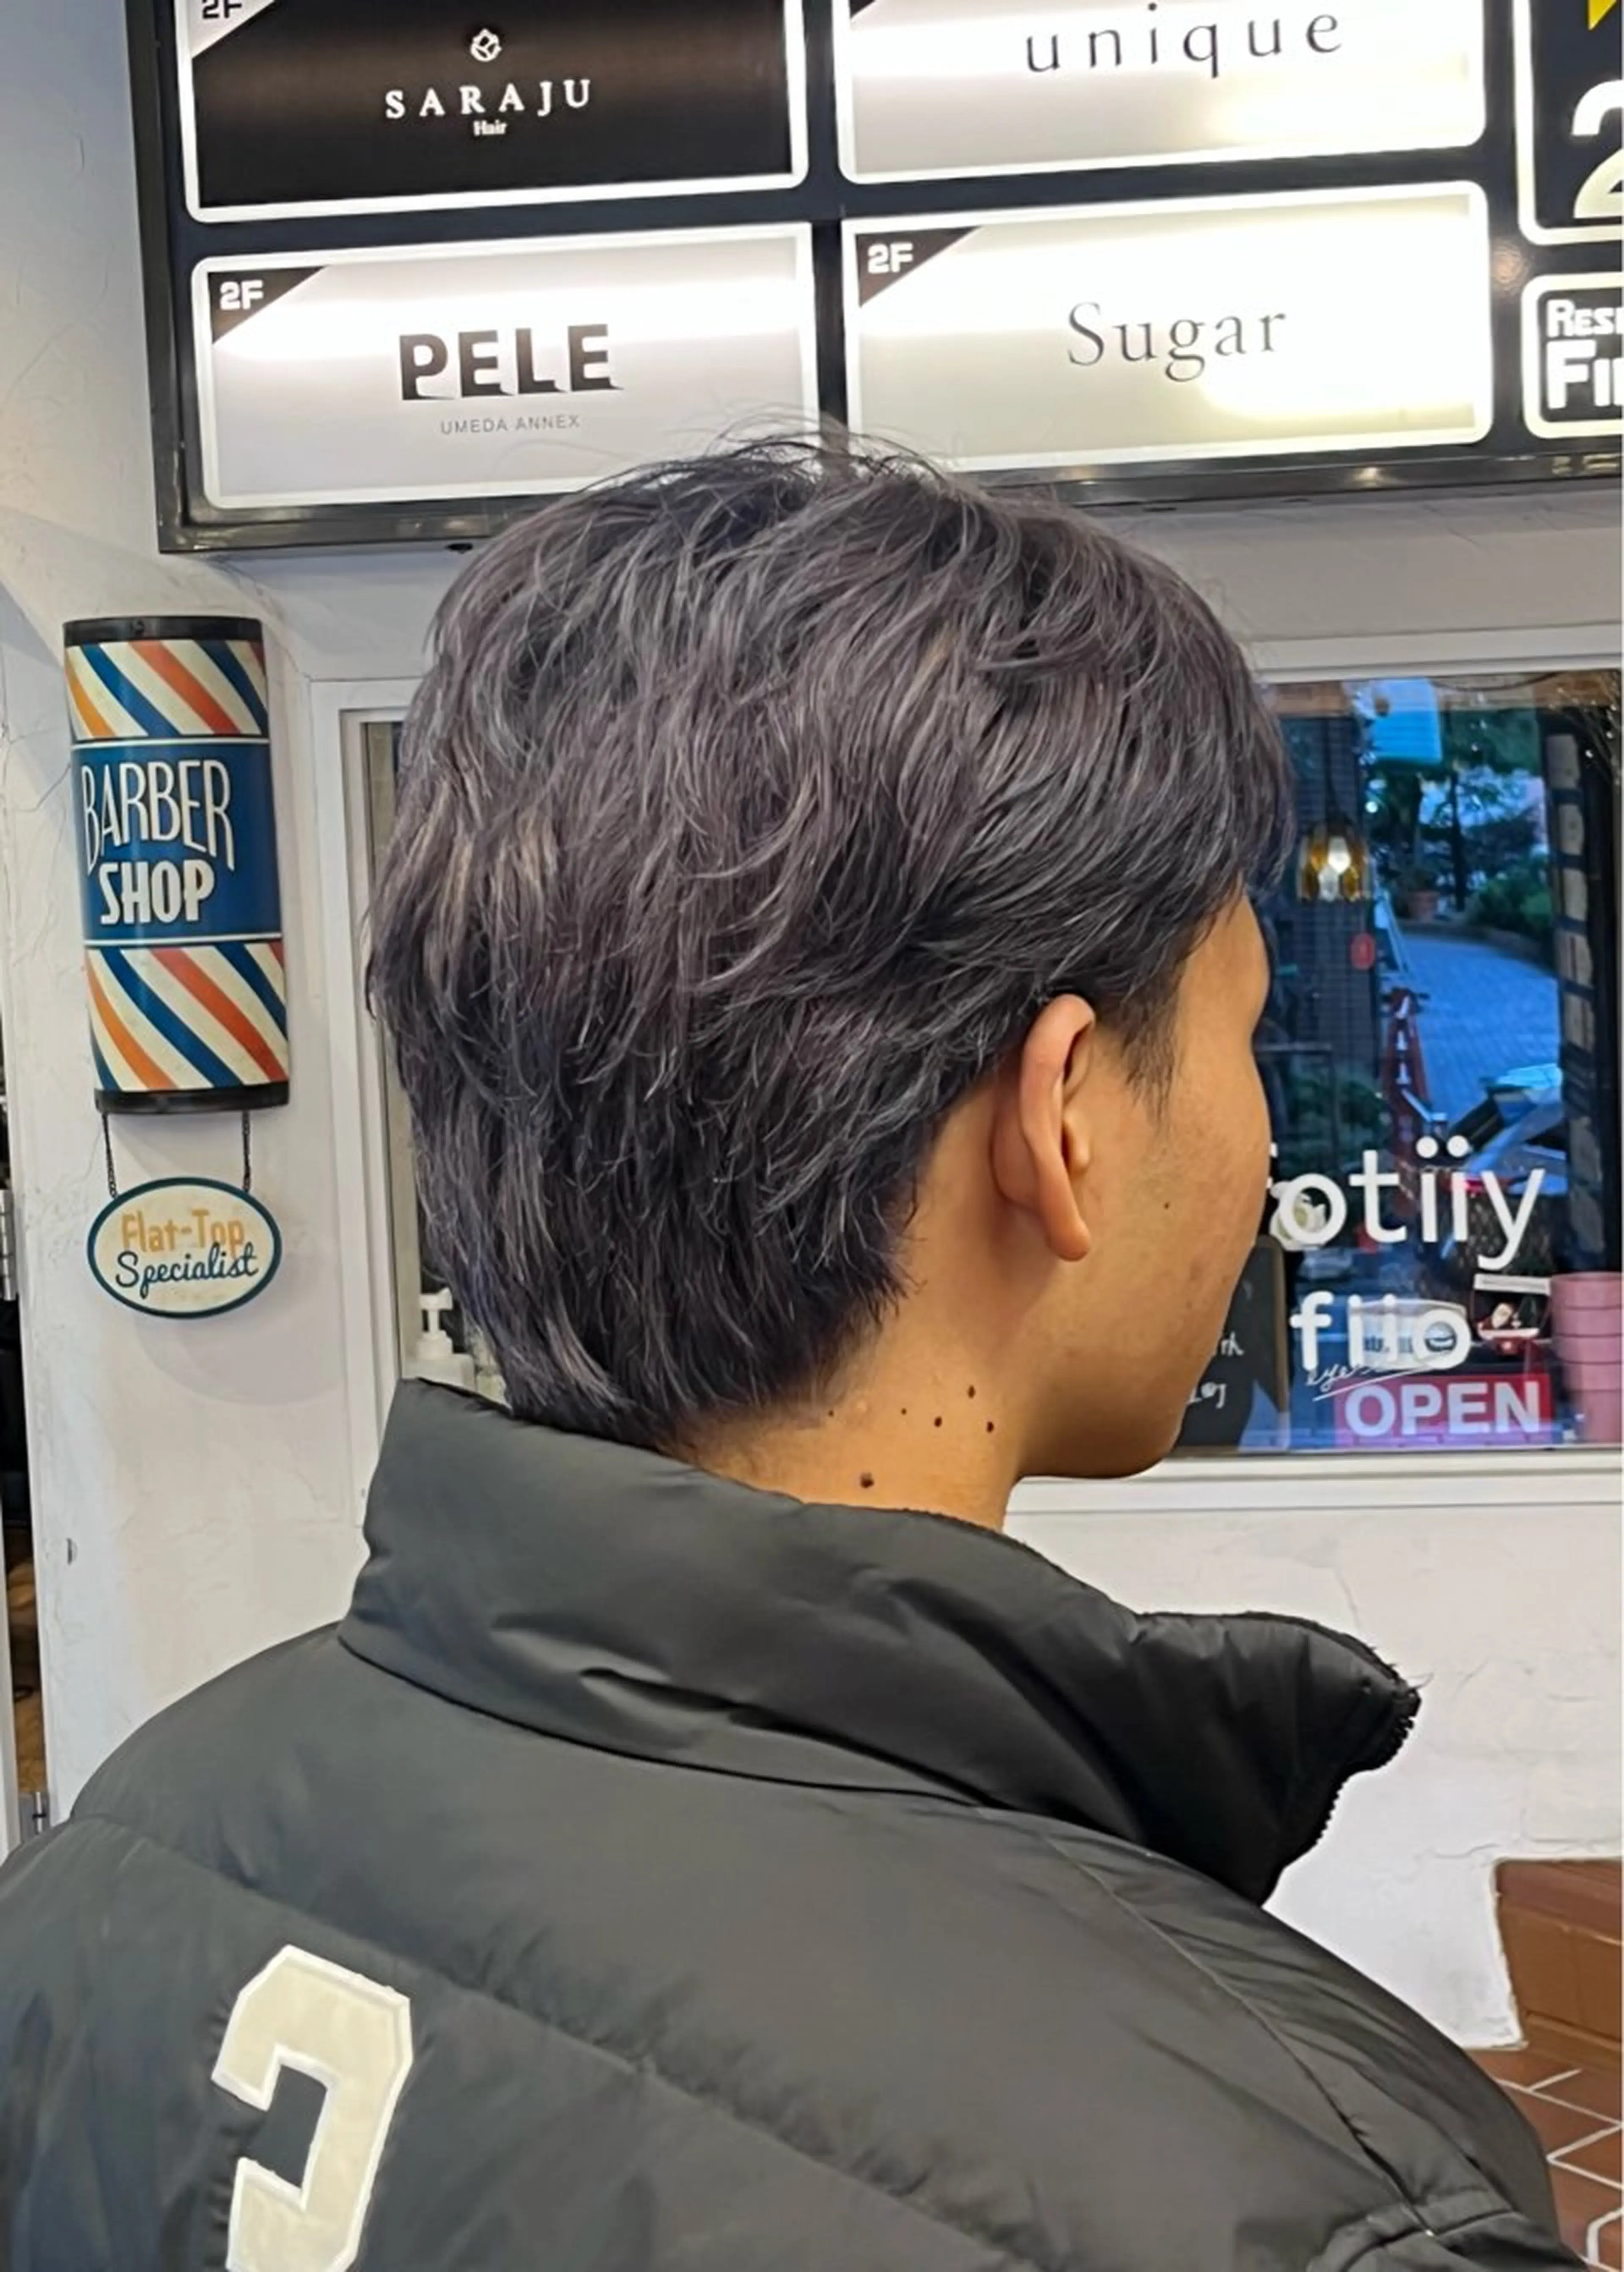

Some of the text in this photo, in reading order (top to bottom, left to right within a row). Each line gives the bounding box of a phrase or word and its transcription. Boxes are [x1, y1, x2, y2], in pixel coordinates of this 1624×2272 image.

[1026, 3, 1343, 79] unique
[385, 79, 591, 118] SARAJU
[473, 119, 507, 136] Hair
[867, 242, 914, 275] 2F
[219, 280, 264, 310] 2F
[399, 324, 623, 400] PELE
[1068, 302, 1286, 383] Sugar
[441, 414, 580, 435] UMEDA ANNEX
[82, 760, 235, 876] BARBER
[99, 859, 215, 925] SHOP
[120, 1208, 245, 1261] Flat-Top
[115, 1241, 259, 1300] Specialist
[1345, 1380, 1539, 1437] OPEN
